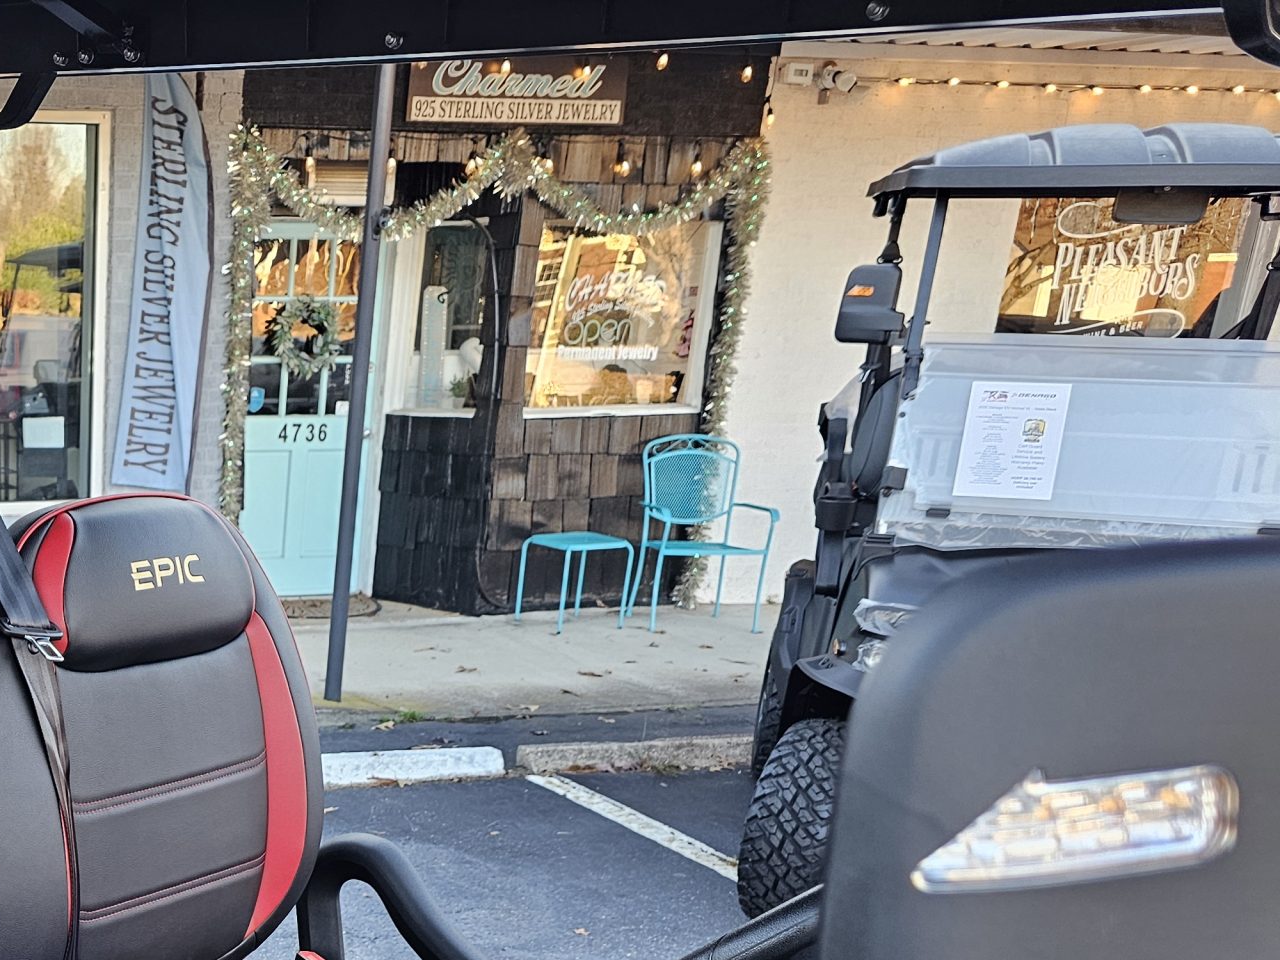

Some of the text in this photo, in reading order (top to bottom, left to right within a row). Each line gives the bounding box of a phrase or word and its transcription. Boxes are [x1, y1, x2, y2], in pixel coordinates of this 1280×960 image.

[432, 60, 607, 98] Charmed
[414, 100, 618, 122] 925 STERLING SILVER JEWELRY
[1051, 225, 1187, 289] PLEASANT
[123, 96, 188, 476] STERLING SILVER JEWELRY
[1119, 321, 1143, 334] BEER
[557, 345, 616, 360] Permanent
[278, 423, 328, 443] 4736
[130, 554, 205, 591] EPIC
